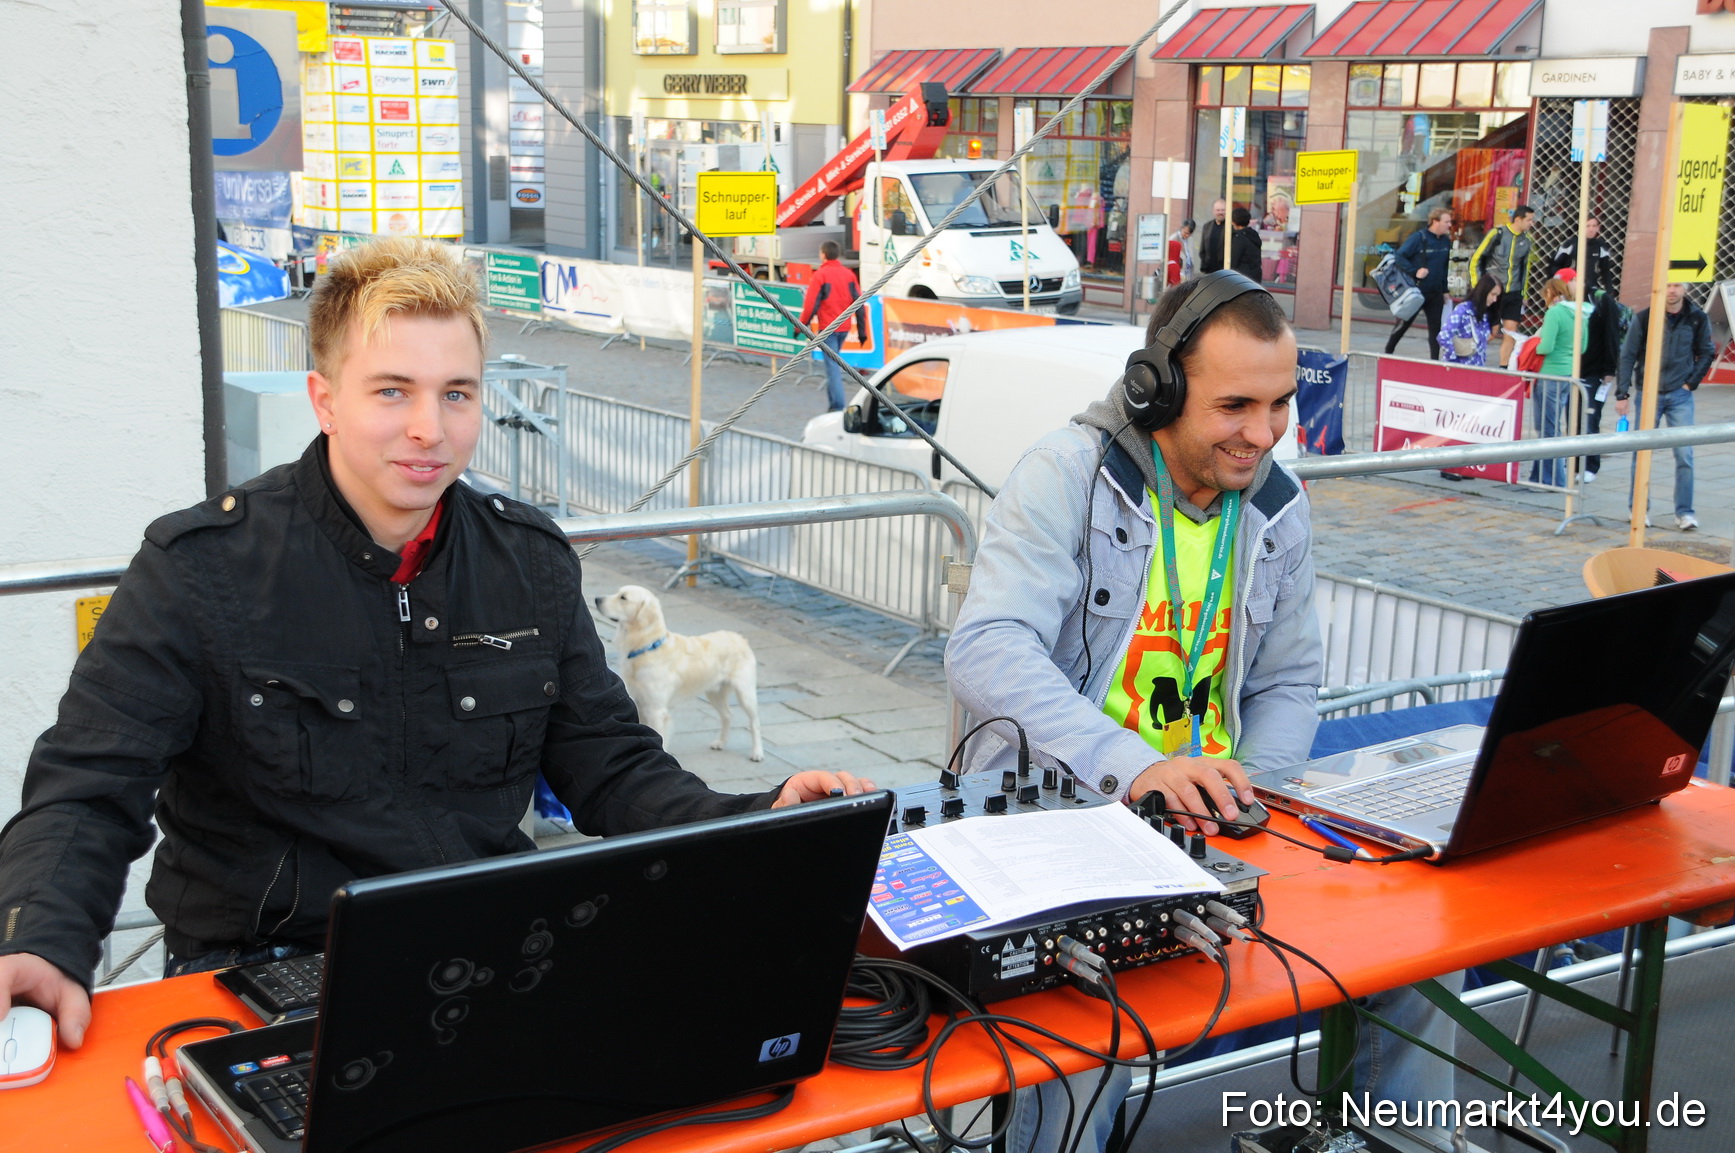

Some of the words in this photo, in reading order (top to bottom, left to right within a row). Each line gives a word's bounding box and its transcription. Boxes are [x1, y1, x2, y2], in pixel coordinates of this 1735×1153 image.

[1541, 72, 1597, 84] GARDINEN
[1682, 69, 1712, 81] BABY
[1715, 69, 1725, 80] &
[663, 73, 702, 94] GERRY
[703, 74, 748, 96] WEBER
[377, 128, 414, 139] Sinupret
[377, 141, 399, 149] forte
[1300, 167, 1352, 178] Schnupper-
[1677, 155, 1722, 186] ugend-
[1317, 180, 1334, 190] lauf
[703, 191, 770, 205] Schnupper-
[1679, 187, 1707, 213] lauf
[725, 208, 747, 220] lauf
[737, 306, 748, 317] Fun
[749, 307, 754, 318] &
[754, 308, 774, 321] Action
[774, 310, 782, 322] in
[1433, 408, 1506, 439] Wildbad
[1007, 961, 1030, 970] ATTENTION
